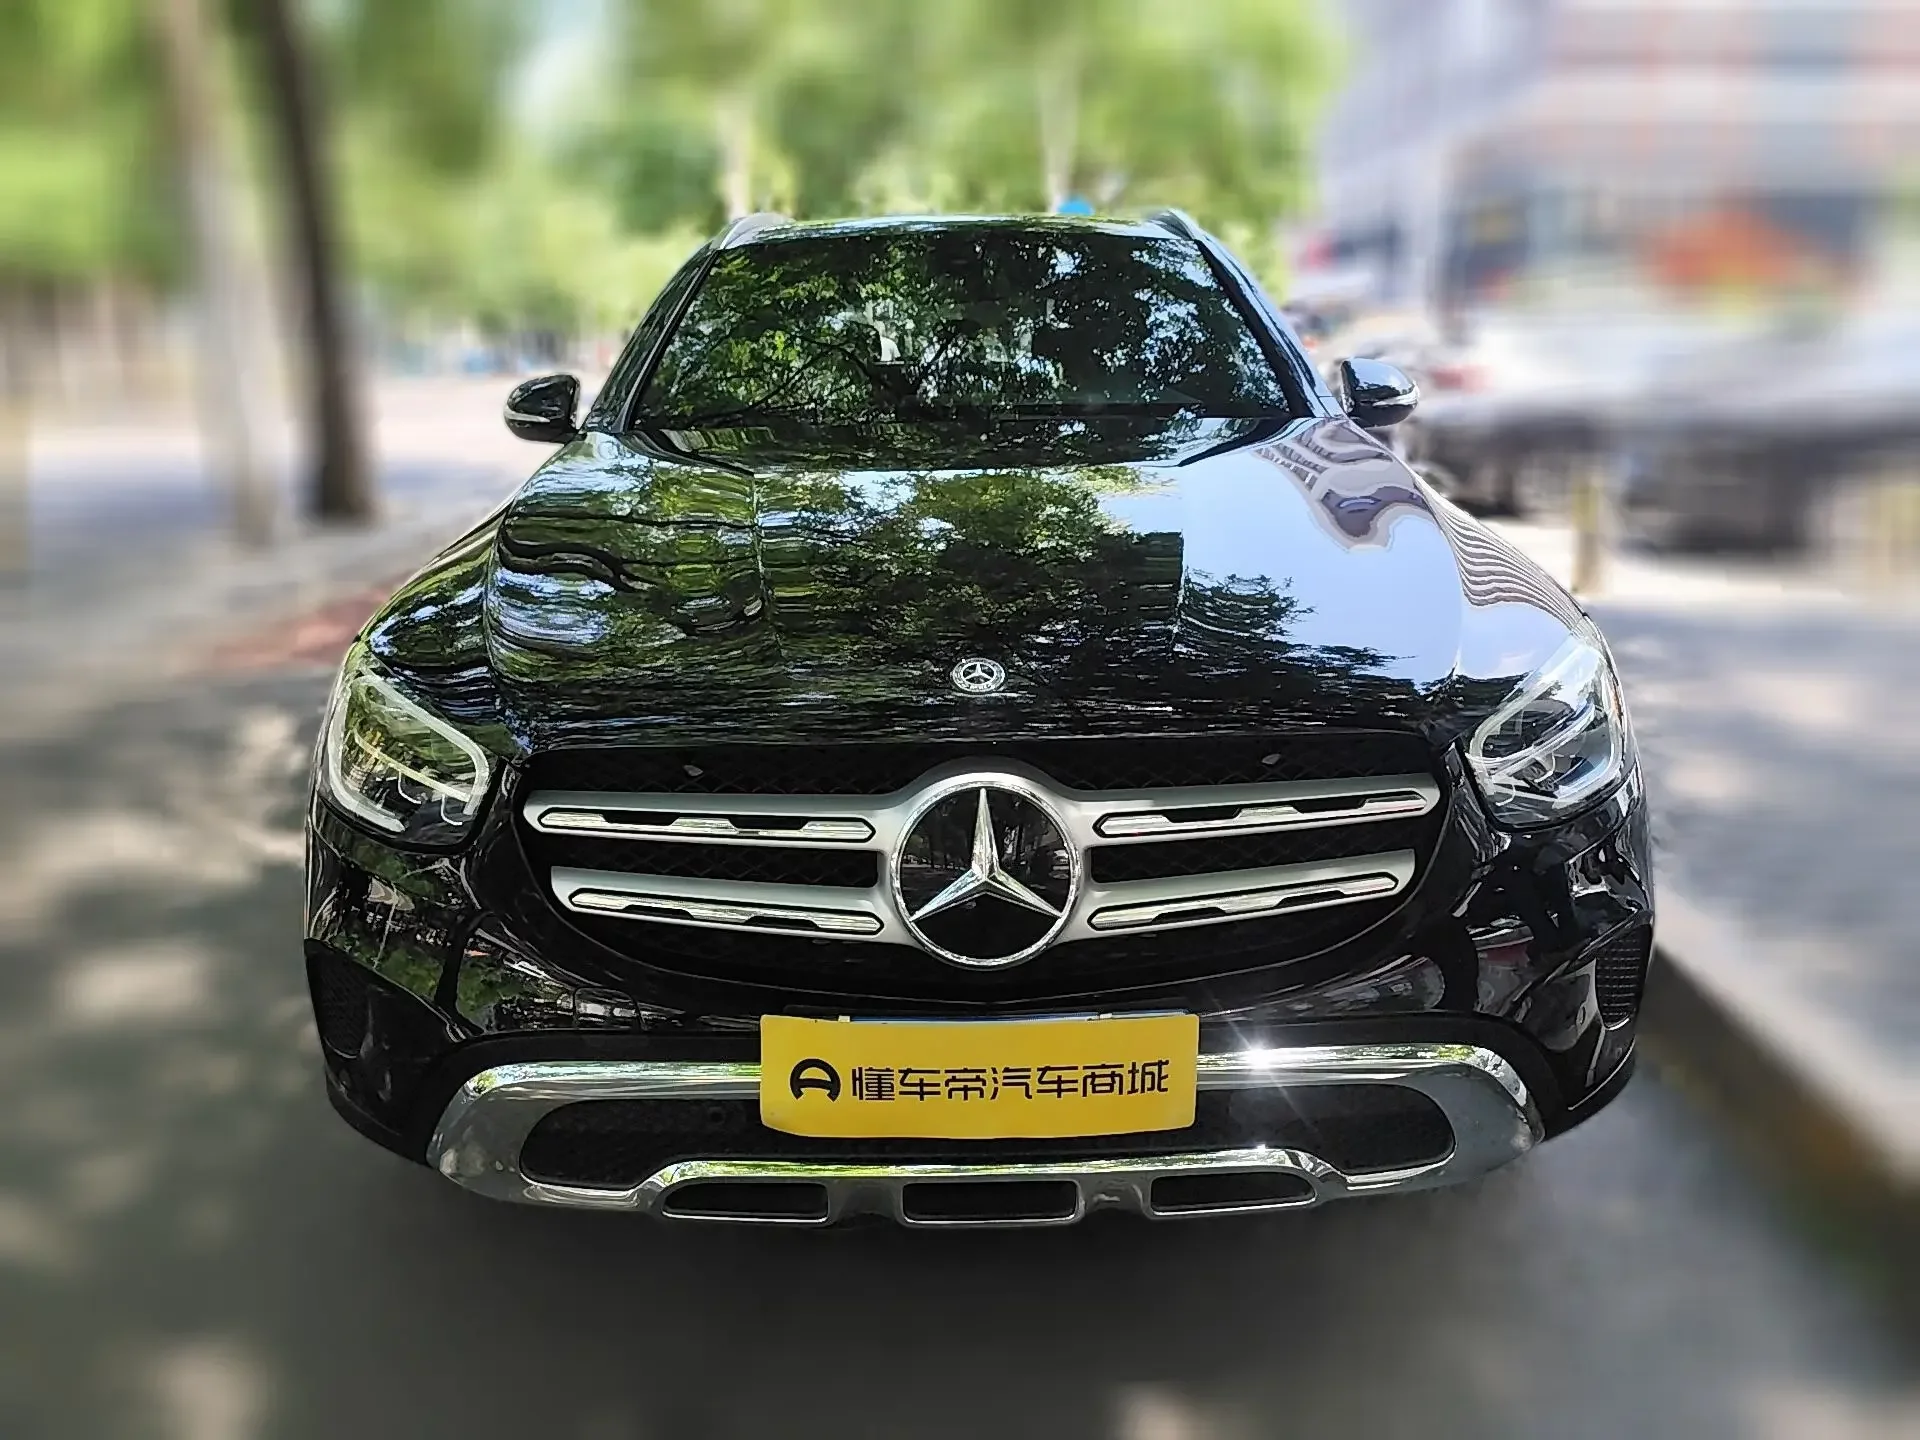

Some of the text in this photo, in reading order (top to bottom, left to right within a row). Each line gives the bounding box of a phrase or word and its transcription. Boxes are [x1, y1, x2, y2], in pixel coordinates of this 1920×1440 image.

[852, 1059, 1170, 1102] 懂车帝汽车商城
